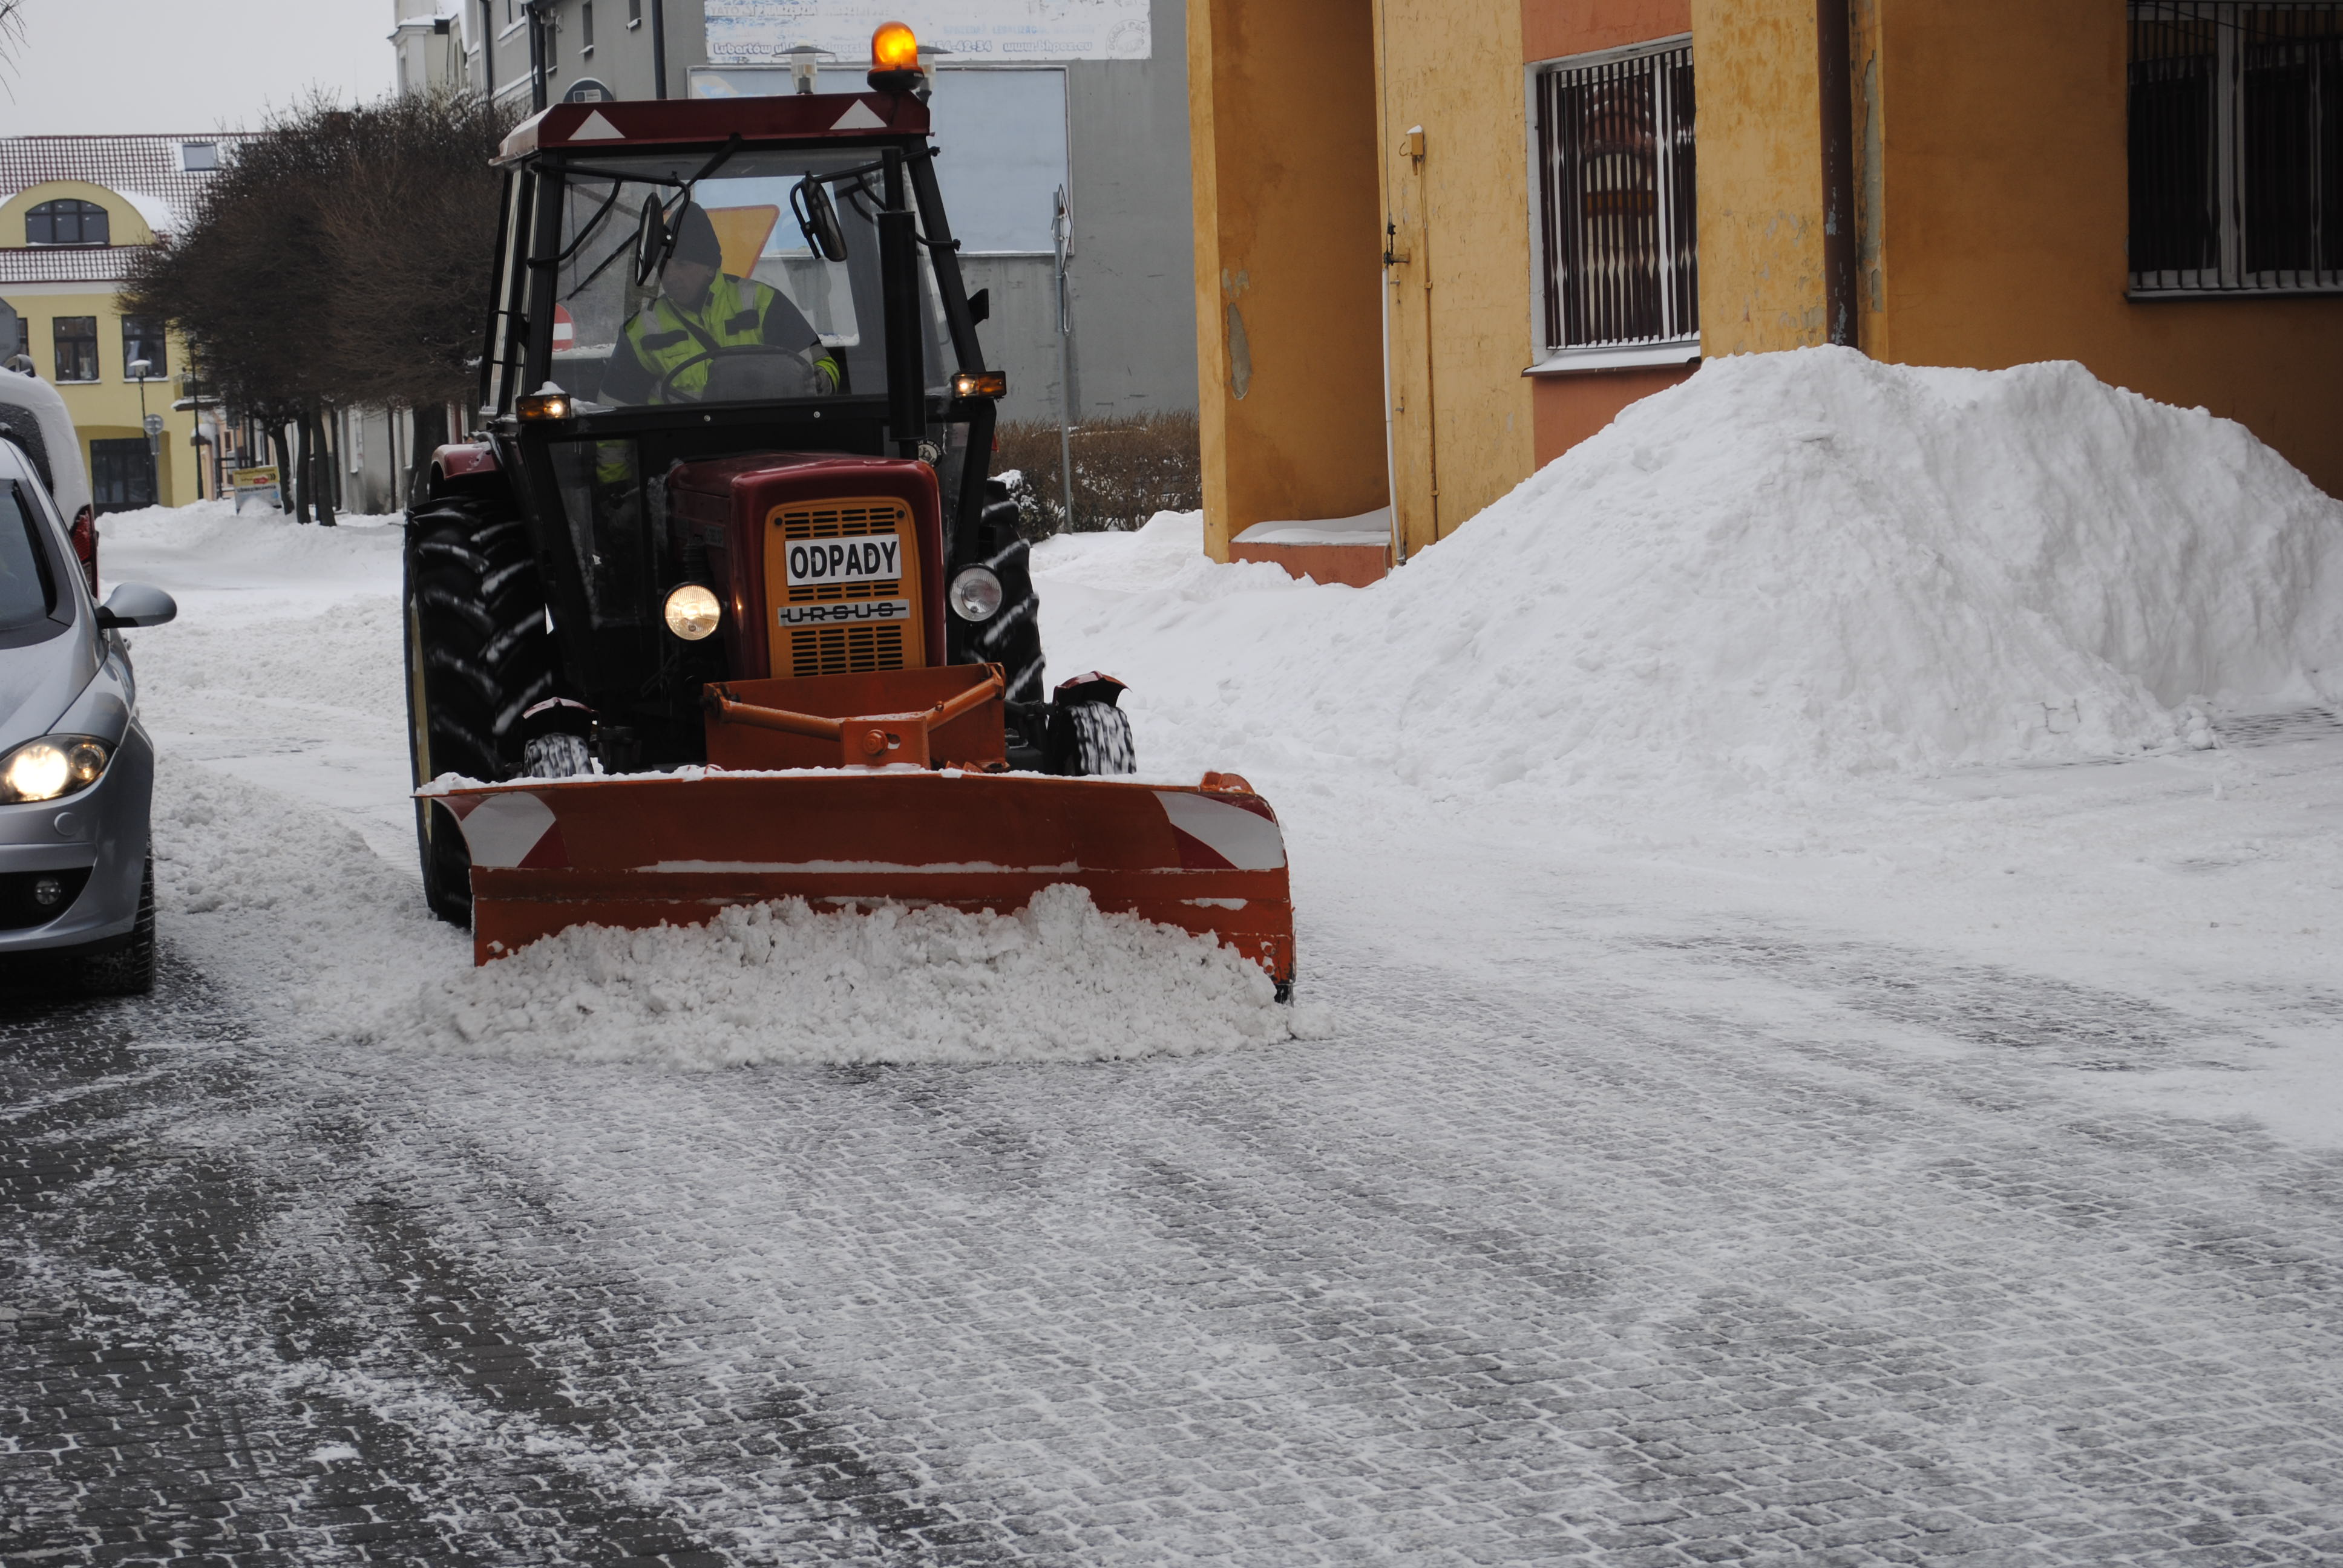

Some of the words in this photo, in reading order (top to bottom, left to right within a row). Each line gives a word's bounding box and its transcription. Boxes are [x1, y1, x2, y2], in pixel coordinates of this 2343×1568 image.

[713, 42, 772, 55] Lubartów
[790, 541, 897, 579] ODPADY
[787, 602, 894, 622] URSUS
